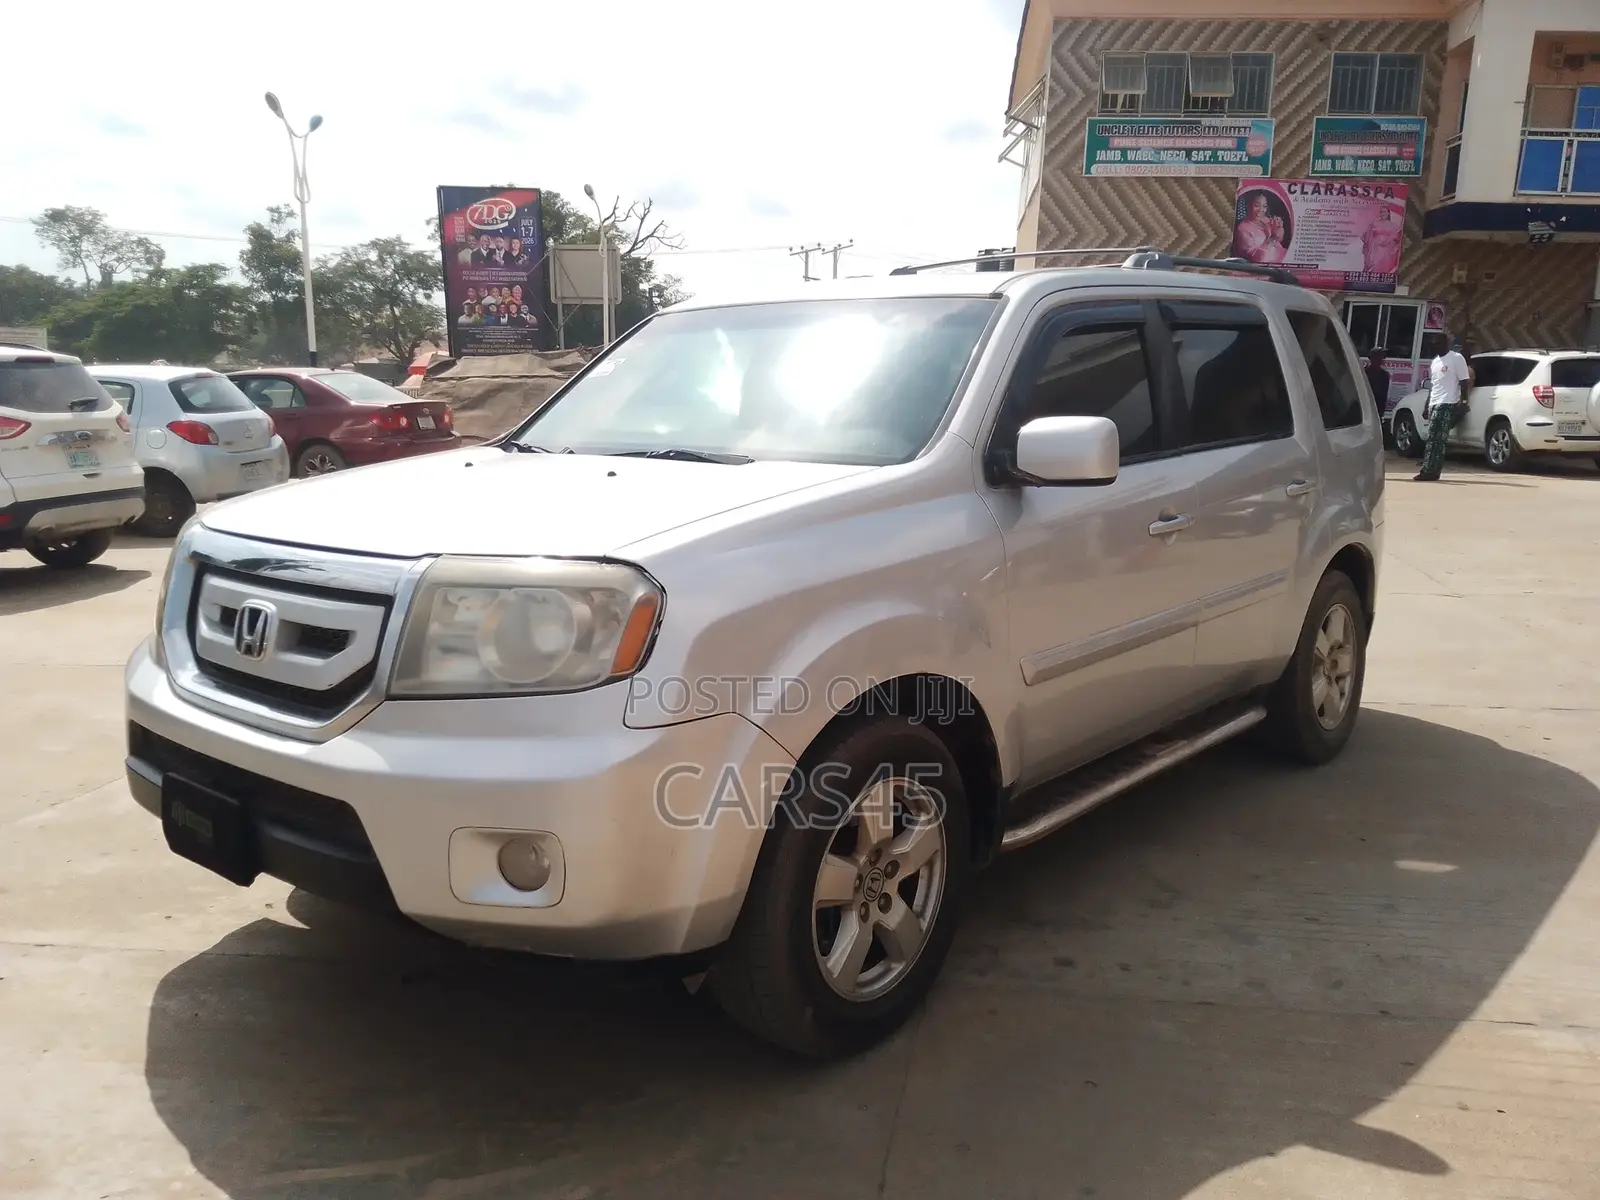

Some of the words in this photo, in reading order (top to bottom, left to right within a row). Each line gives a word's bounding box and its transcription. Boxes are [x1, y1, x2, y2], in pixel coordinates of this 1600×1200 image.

[1096, 124, 1128, 136] UNCLE
[1136, 124, 1161, 136] ELITE
[1161, 124, 1201, 137] TUTORS
[1217, 151, 1249, 162] TOEFL
[1395, 160, 1416, 172] TOEFL
[1287, 182, 1395, 199] CLARASSPA
[520, 219, 534, 227] JULY
[520, 227, 534, 237] 1-7
